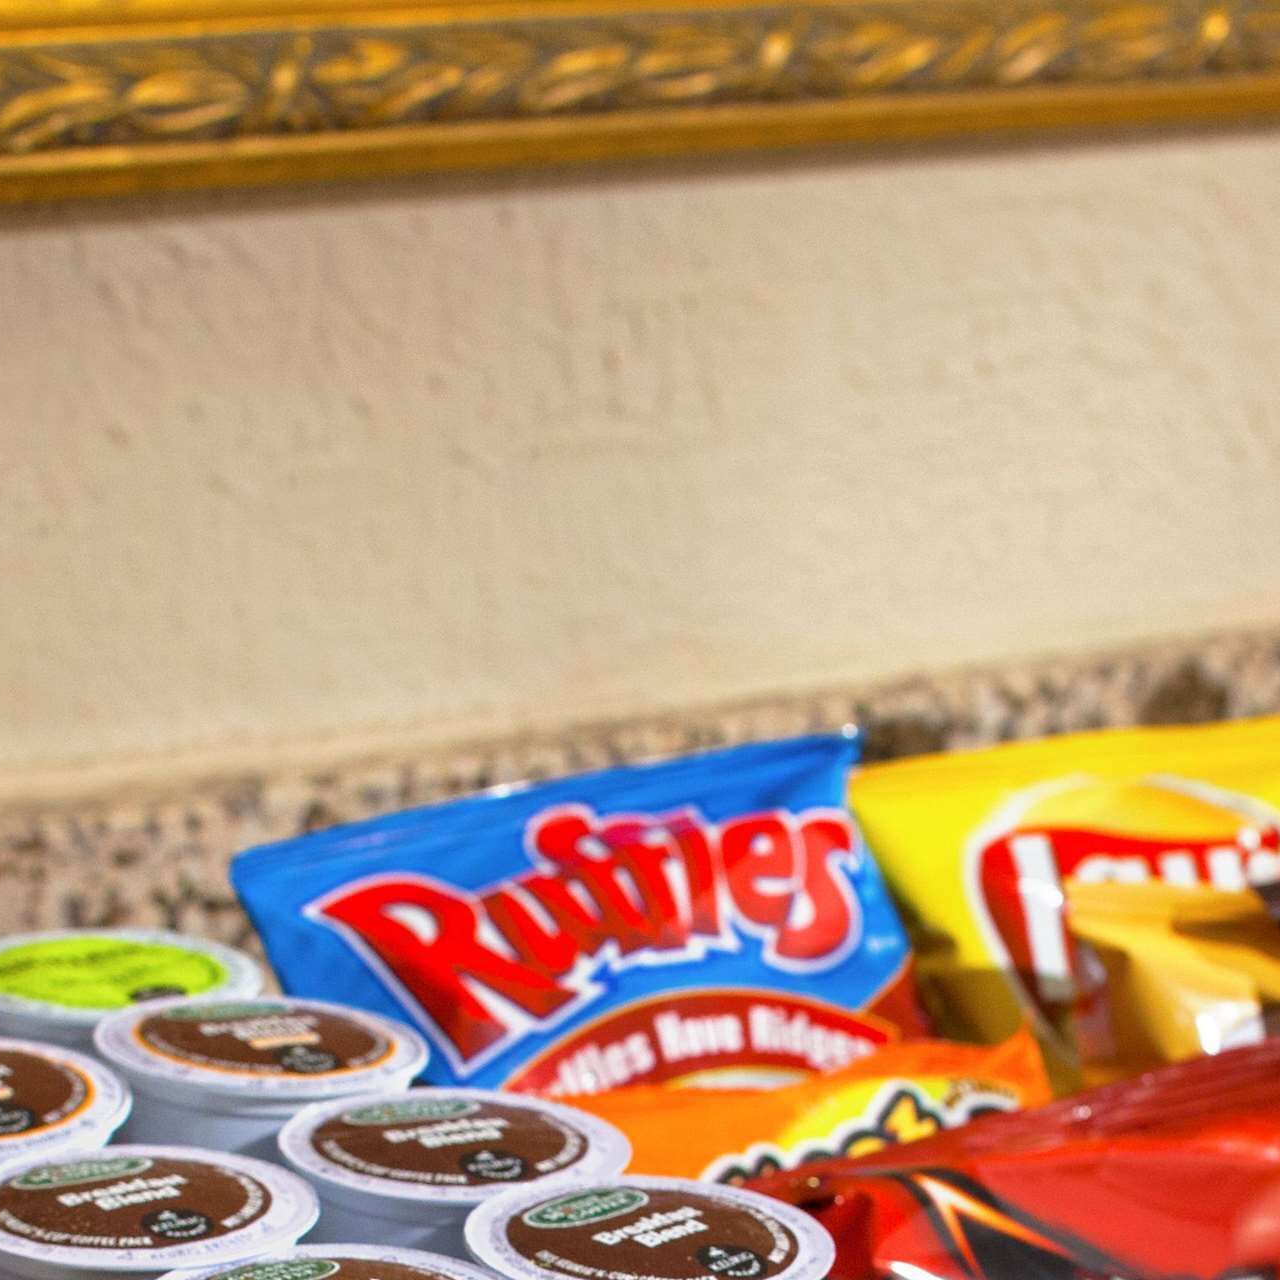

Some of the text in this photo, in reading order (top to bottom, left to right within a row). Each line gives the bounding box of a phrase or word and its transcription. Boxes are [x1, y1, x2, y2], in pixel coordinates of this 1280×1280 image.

[310, 805, 862, 1070] Ruffles
[653, 1011, 745, 1062] Have
[592, 1206, 704, 1246] Breakfast
[631, 1218, 709, 1248] Blend
